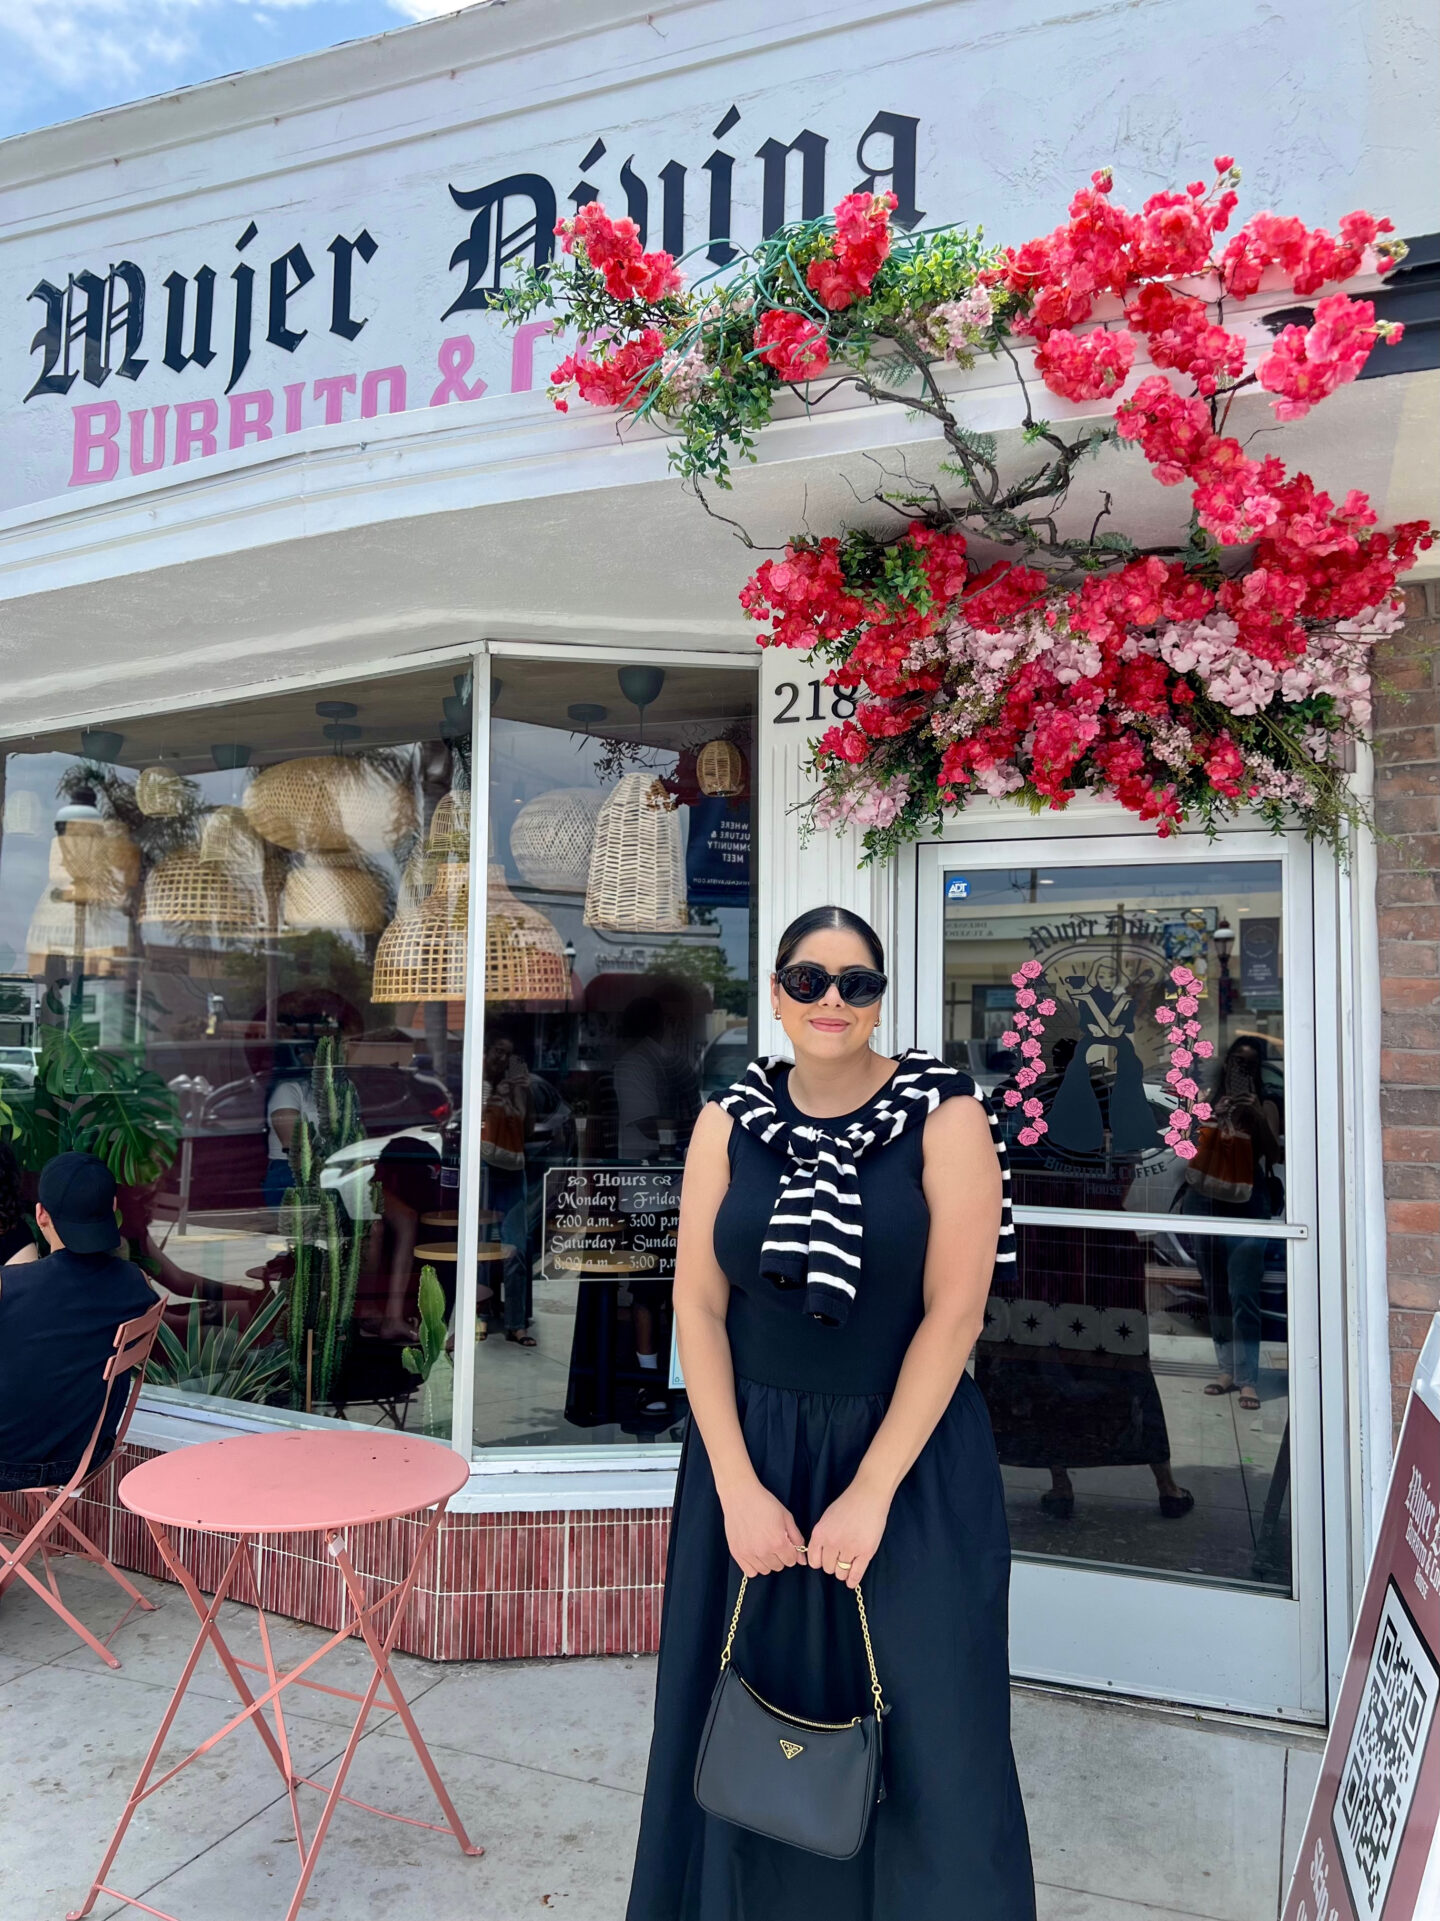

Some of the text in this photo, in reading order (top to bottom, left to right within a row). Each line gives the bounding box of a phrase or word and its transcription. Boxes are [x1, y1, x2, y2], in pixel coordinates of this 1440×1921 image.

[23, 221, 379, 403] Mujer
[430, 334, 488, 408] &
[773, 679, 857, 725] 218
[949, 883, 968, 893] ADT
[593, 1173, 647, 1187] Hours
[557, 1191, 616, 1212] Monday
[555, 1214, 582, 1228] 7:00
[586, 1217, 614, 1228] a.m.
[629, 1214, 656, 1228] 3:00
[660, 1216, 680, 1232] p.m
[550, 1234, 616, 1255] Saturday
[632, 1234, 677, 1253] Sunda
